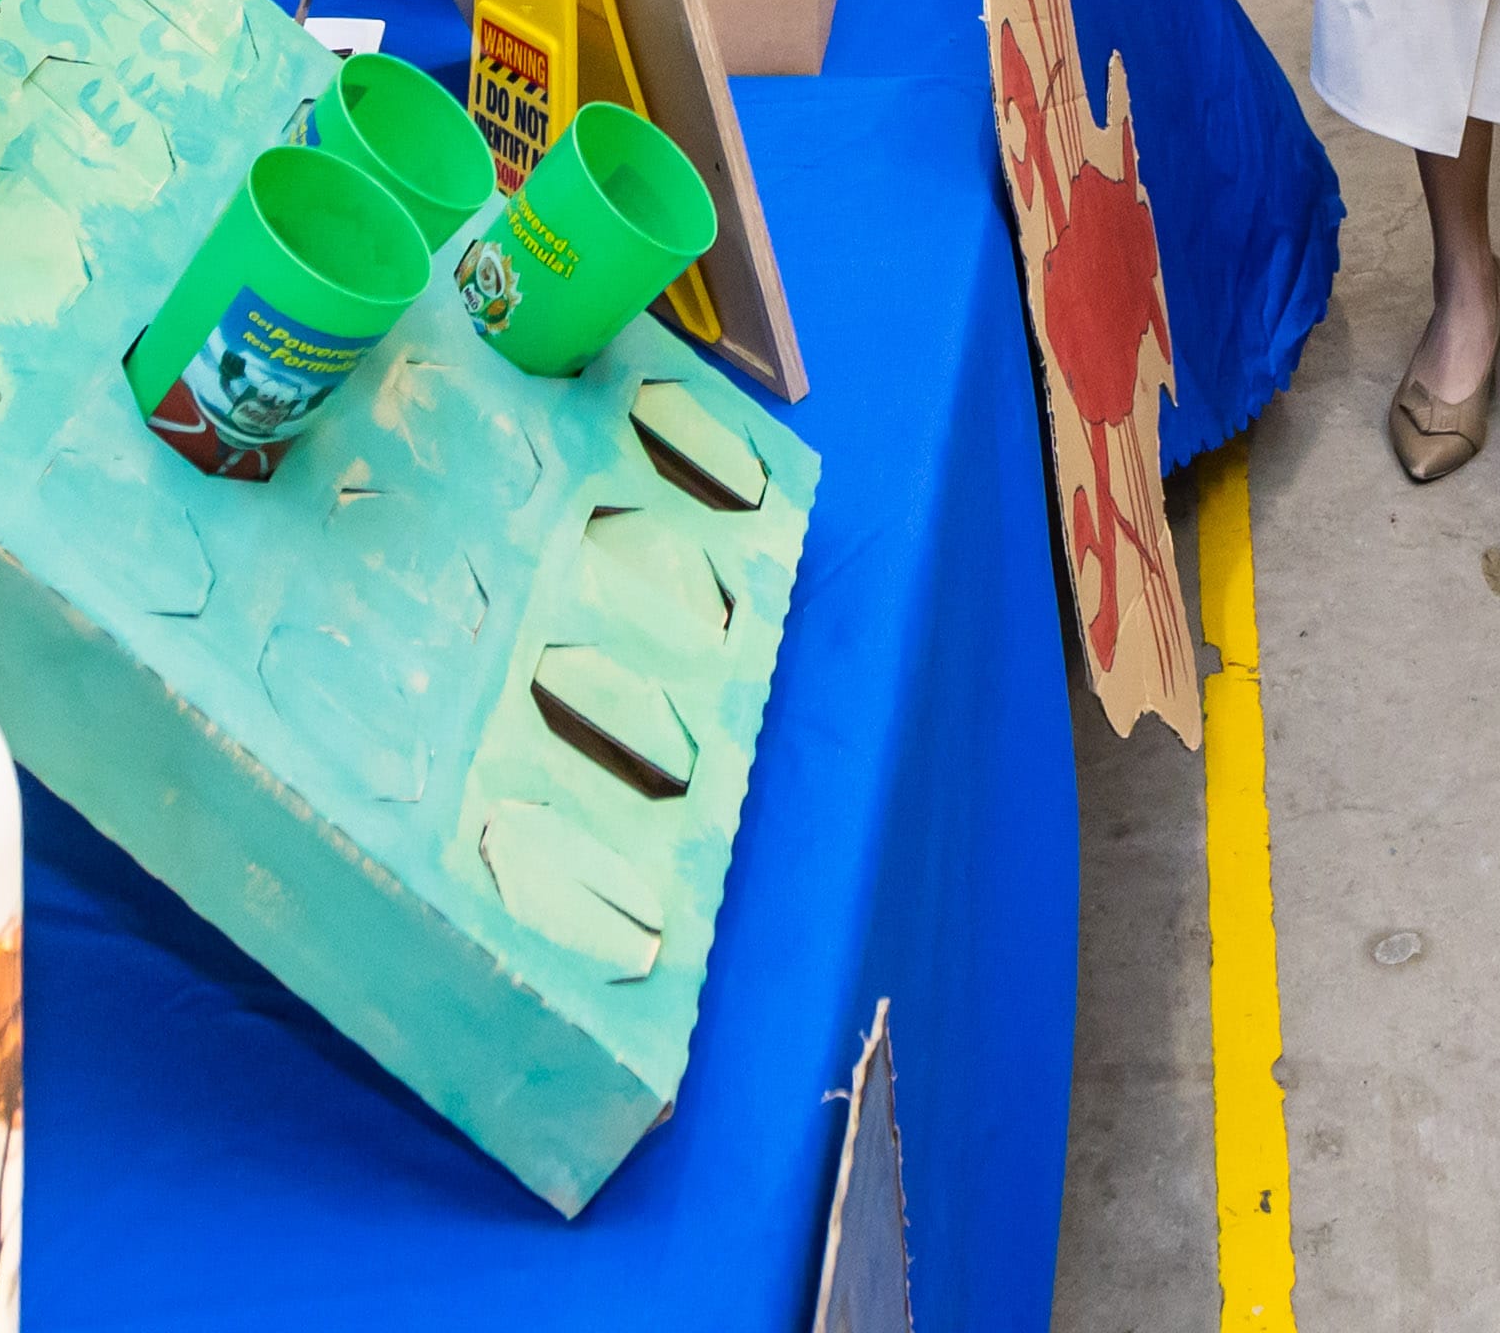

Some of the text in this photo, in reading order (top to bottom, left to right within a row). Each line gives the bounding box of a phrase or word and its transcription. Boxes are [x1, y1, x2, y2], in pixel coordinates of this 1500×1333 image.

[483, 23, 547, 85] WARNING
[475, 72, 549, 147] I DO NOT
[474, 110, 529, 171] IDENTIFY
[464, 287, 479, 311] MILO
[243, 331, 272, 352] New
[248, 311, 273, 331] Get
